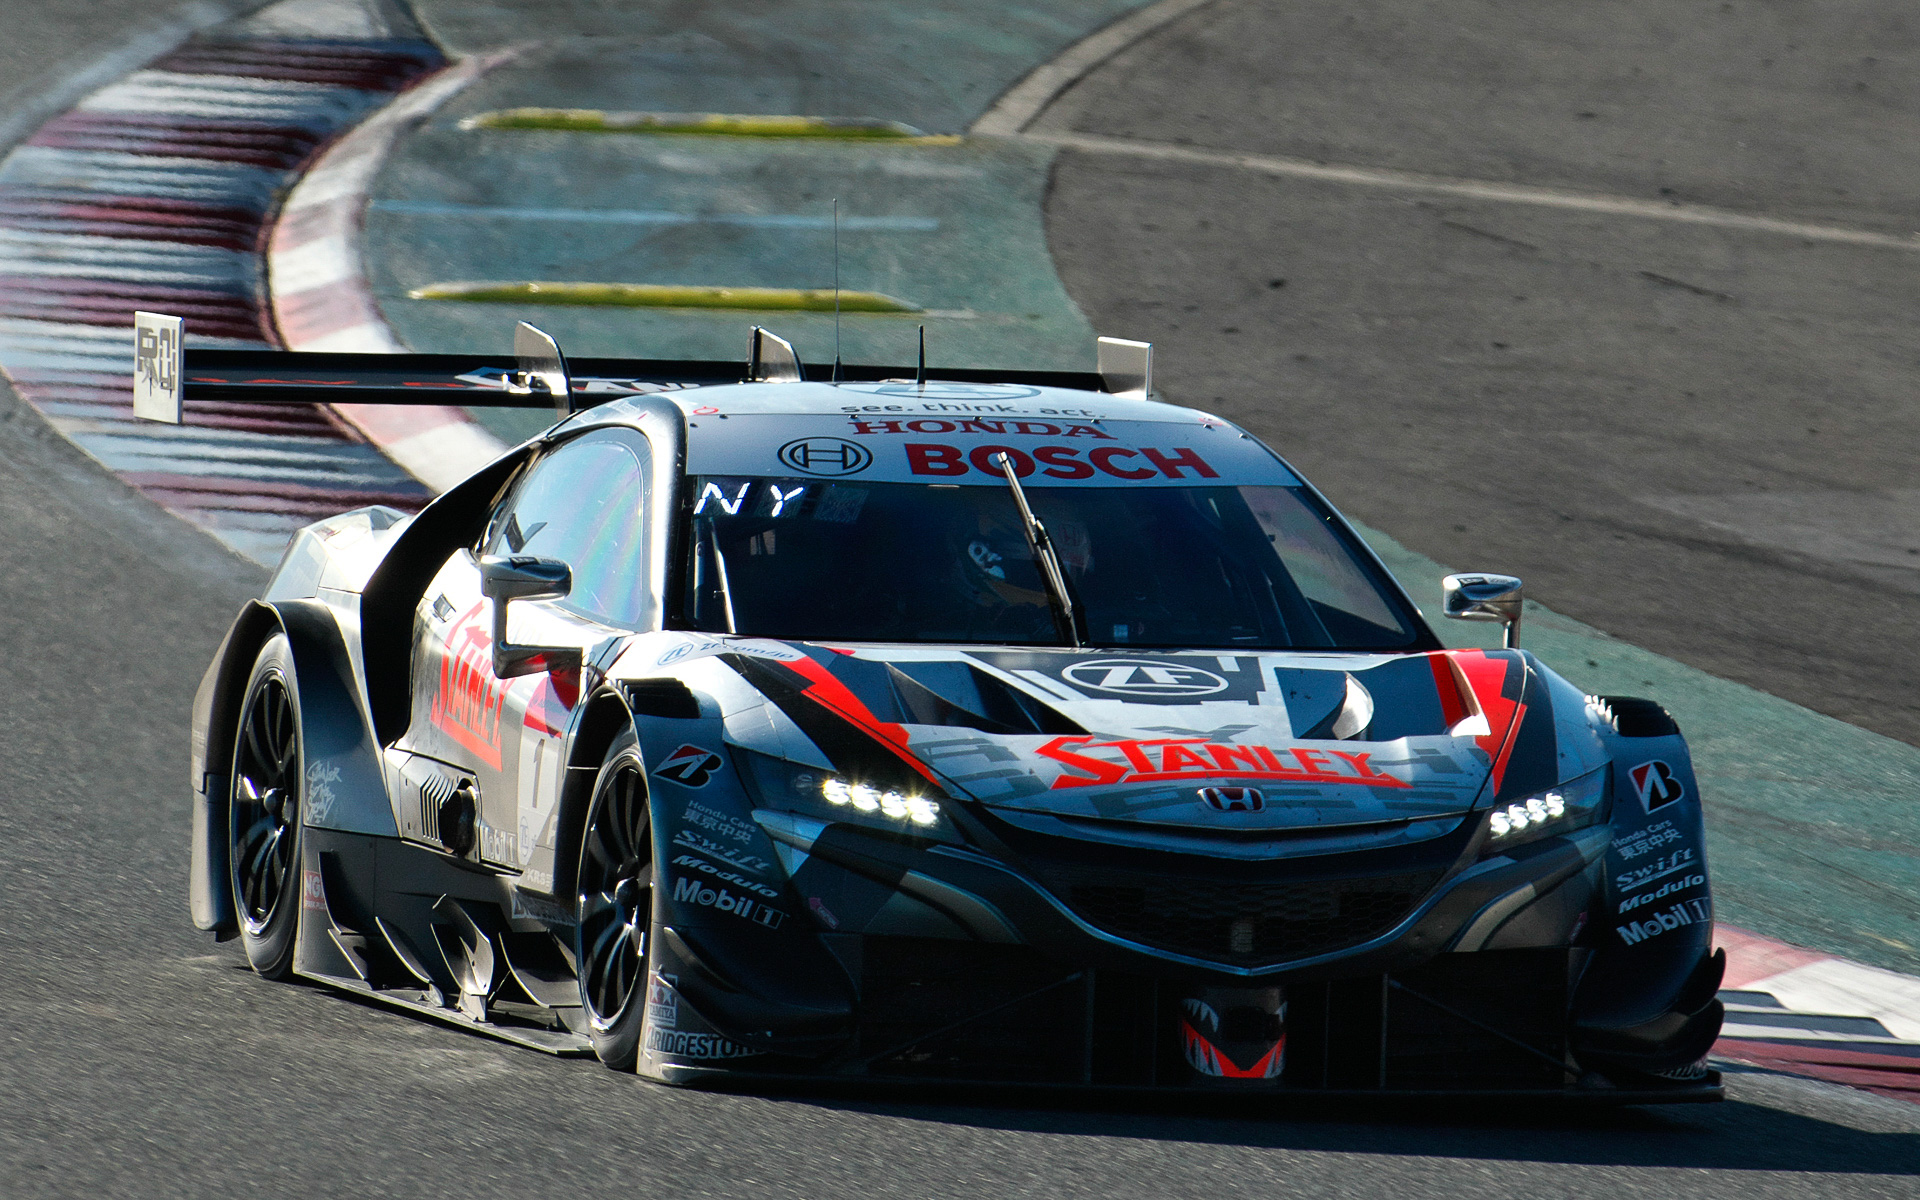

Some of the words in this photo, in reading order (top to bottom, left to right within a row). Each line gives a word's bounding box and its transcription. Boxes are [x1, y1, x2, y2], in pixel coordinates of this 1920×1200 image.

[840, 404, 913, 413] see.
[922, 402, 1029, 414] think.
[1039, 406, 1107, 418] act.
[850, 419, 1117, 440] HONDA
[903, 442, 1221, 480] BOSCH
[531, 737, 546, 809] 1
[1034, 734, 1414, 790] STANLEY
[682, 807, 752, 845] 東京中央
[688, 799, 727, 821] Honda
[729, 816, 757, 832] Cars
[1611, 829, 1647, 848] Honda
[1647, 819, 1673, 833] Cars
[481, 825, 507, 863] Mobil
[1616, 828, 1683, 861] 東京中央
[671, 854, 779, 898] Modulo
[1618, 873, 1705, 915] Modulo
[673, 876, 754, 918] Mobil
[1615, 903, 1693, 946] Mobil
[646, 1028, 763, 1057] BRIDGESTO
